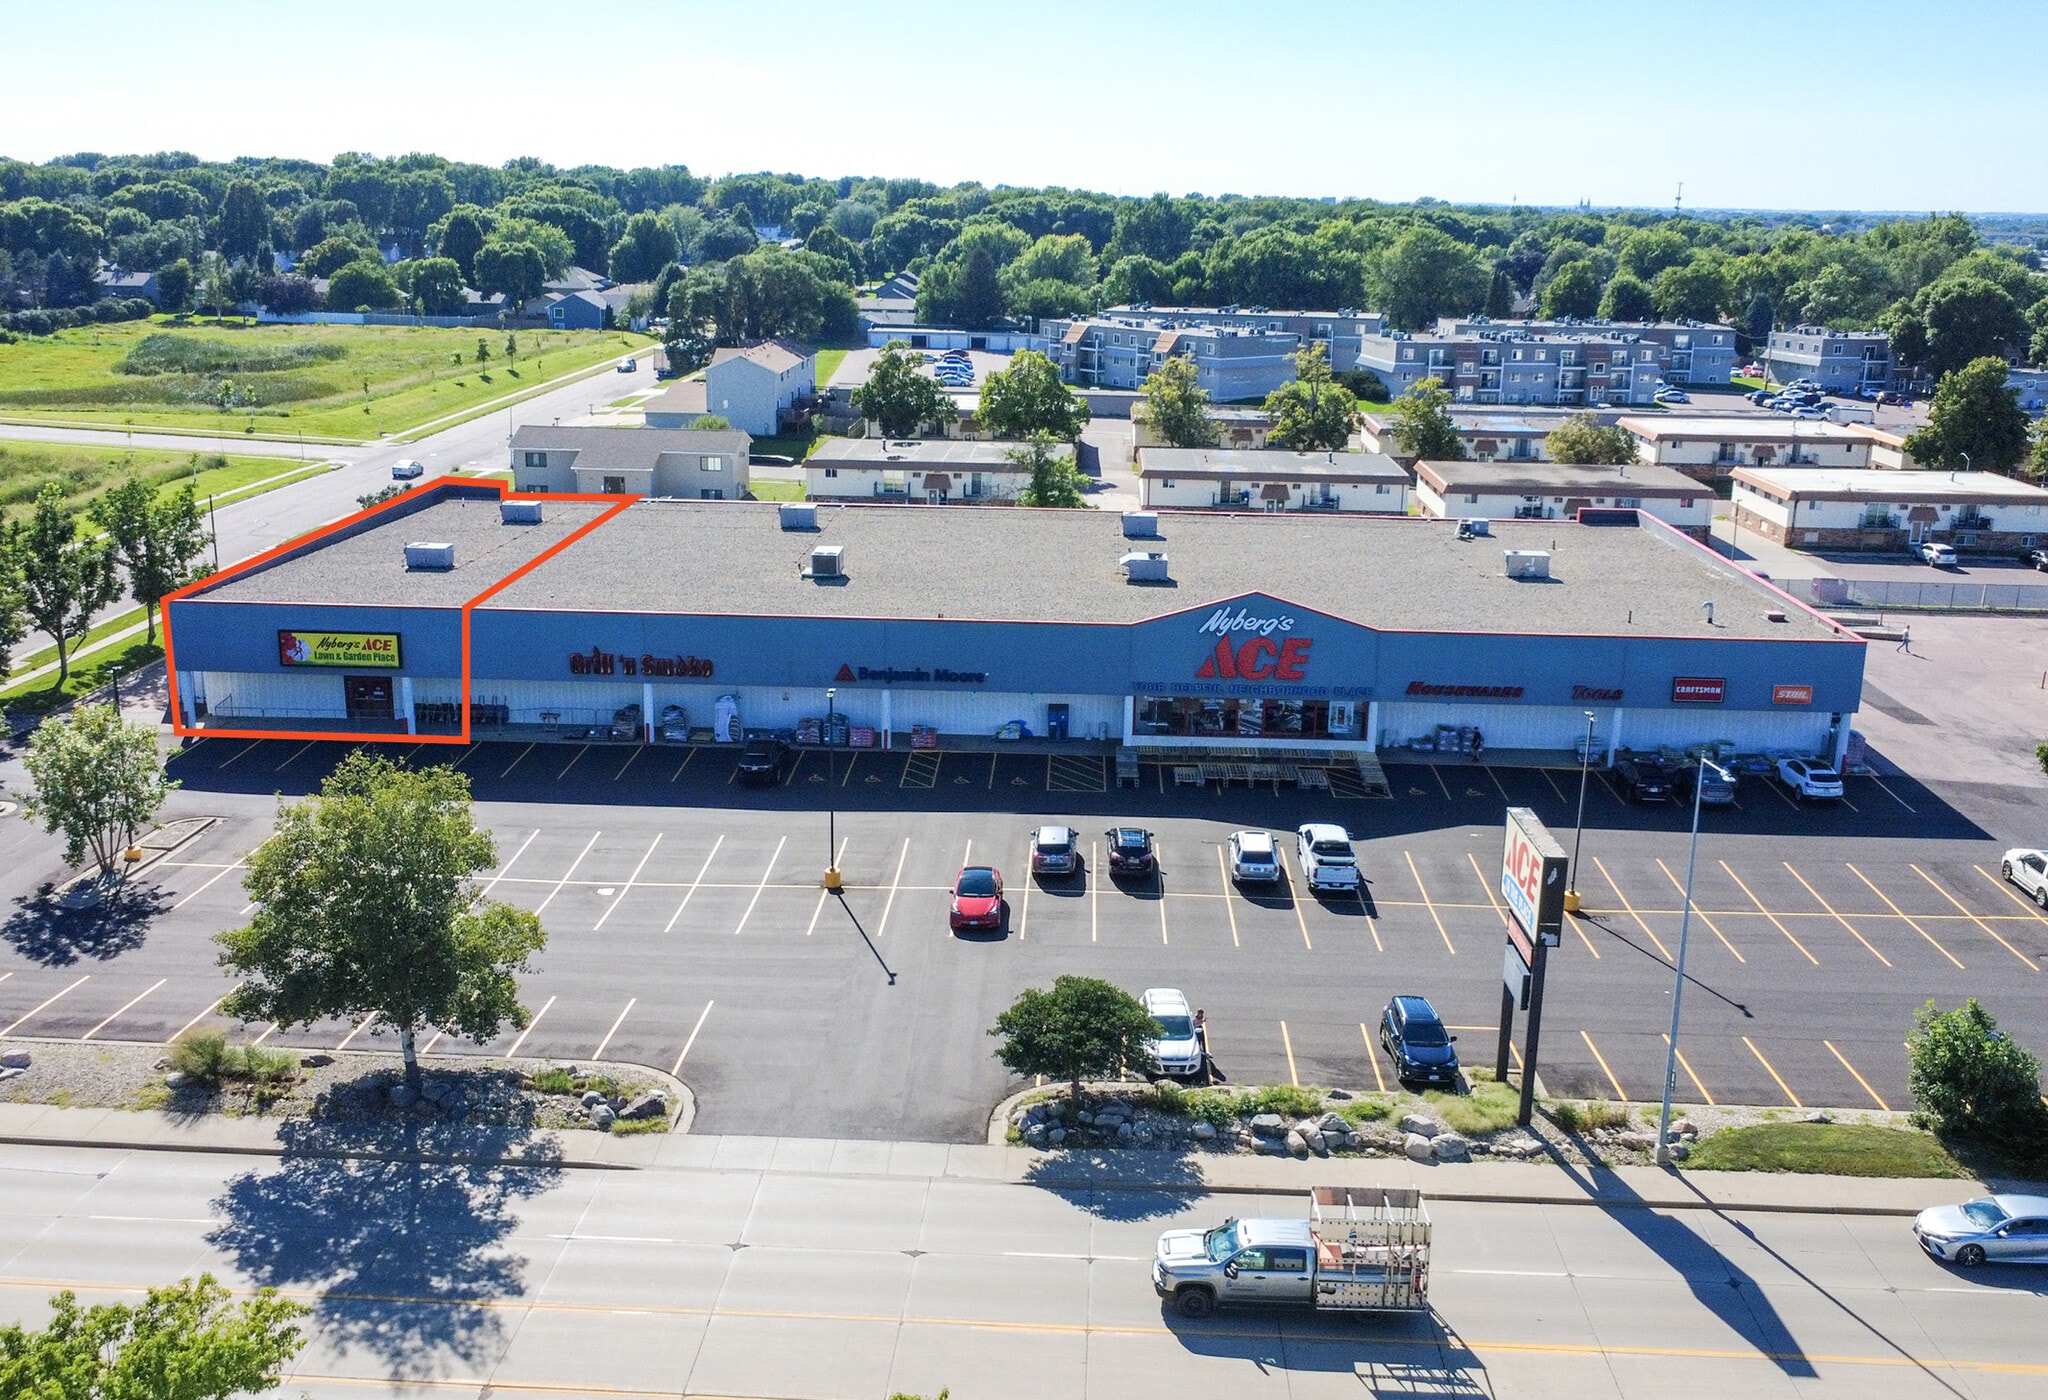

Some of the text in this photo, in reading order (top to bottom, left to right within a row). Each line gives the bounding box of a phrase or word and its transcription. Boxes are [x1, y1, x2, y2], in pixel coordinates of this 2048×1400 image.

[1200, 607, 1295, 636] Nyberg's
[316, 636, 393, 651] Nyberg's ACE
[314, 651, 335, 661] Lawn
[343, 651, 372, 662] Garden
[373, 652, 396, 662] Place
[1195, 634, 1313, 681] ACE
[641, 654, 714, 677] Smoke
[858, 666, 985, 684] Benjamin Moore
[1230, 684, 1328, 697] NEIGHBORHOOD
[1676, 686, 1721, 694] CRAFTSMAN
[1776, 690, 1809, 699] STIHL
[1506, 831, 1540, 903] ACE
